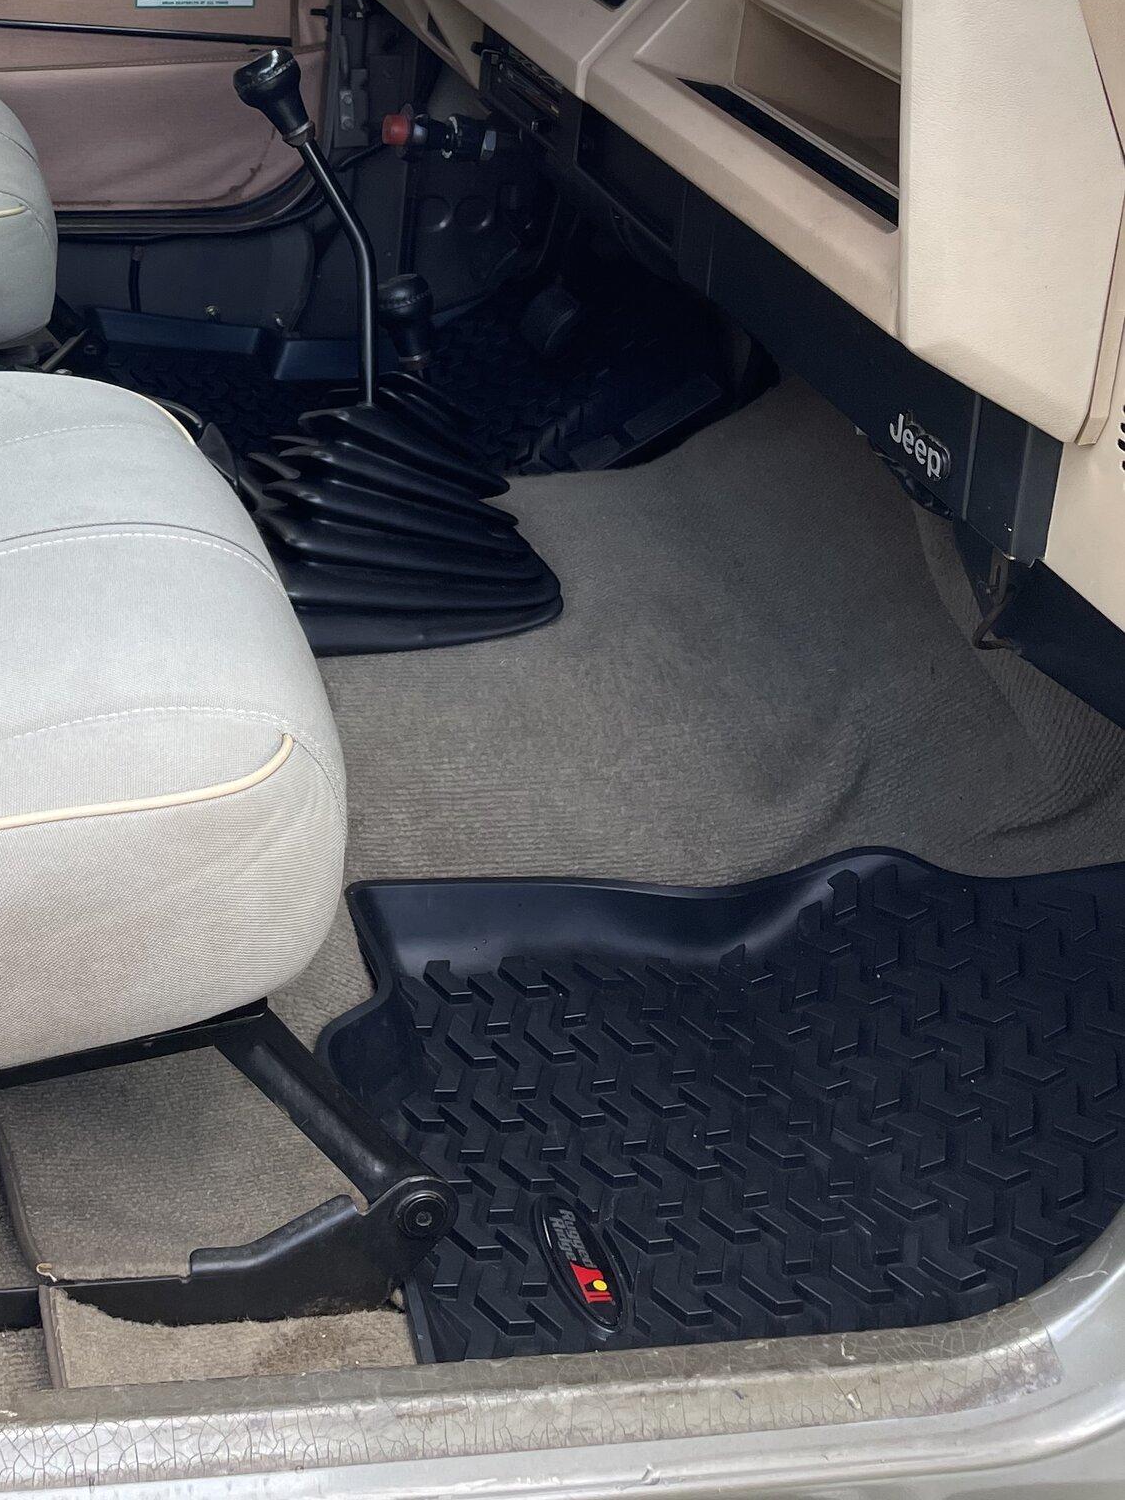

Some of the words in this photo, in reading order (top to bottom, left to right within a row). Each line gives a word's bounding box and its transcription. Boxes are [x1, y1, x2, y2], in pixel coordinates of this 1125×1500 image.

[889, 413, 941, 478] Jeep
[549, 1216, 578, 1262] Ridge
[559, 1209, 598, 1269] Rugged
